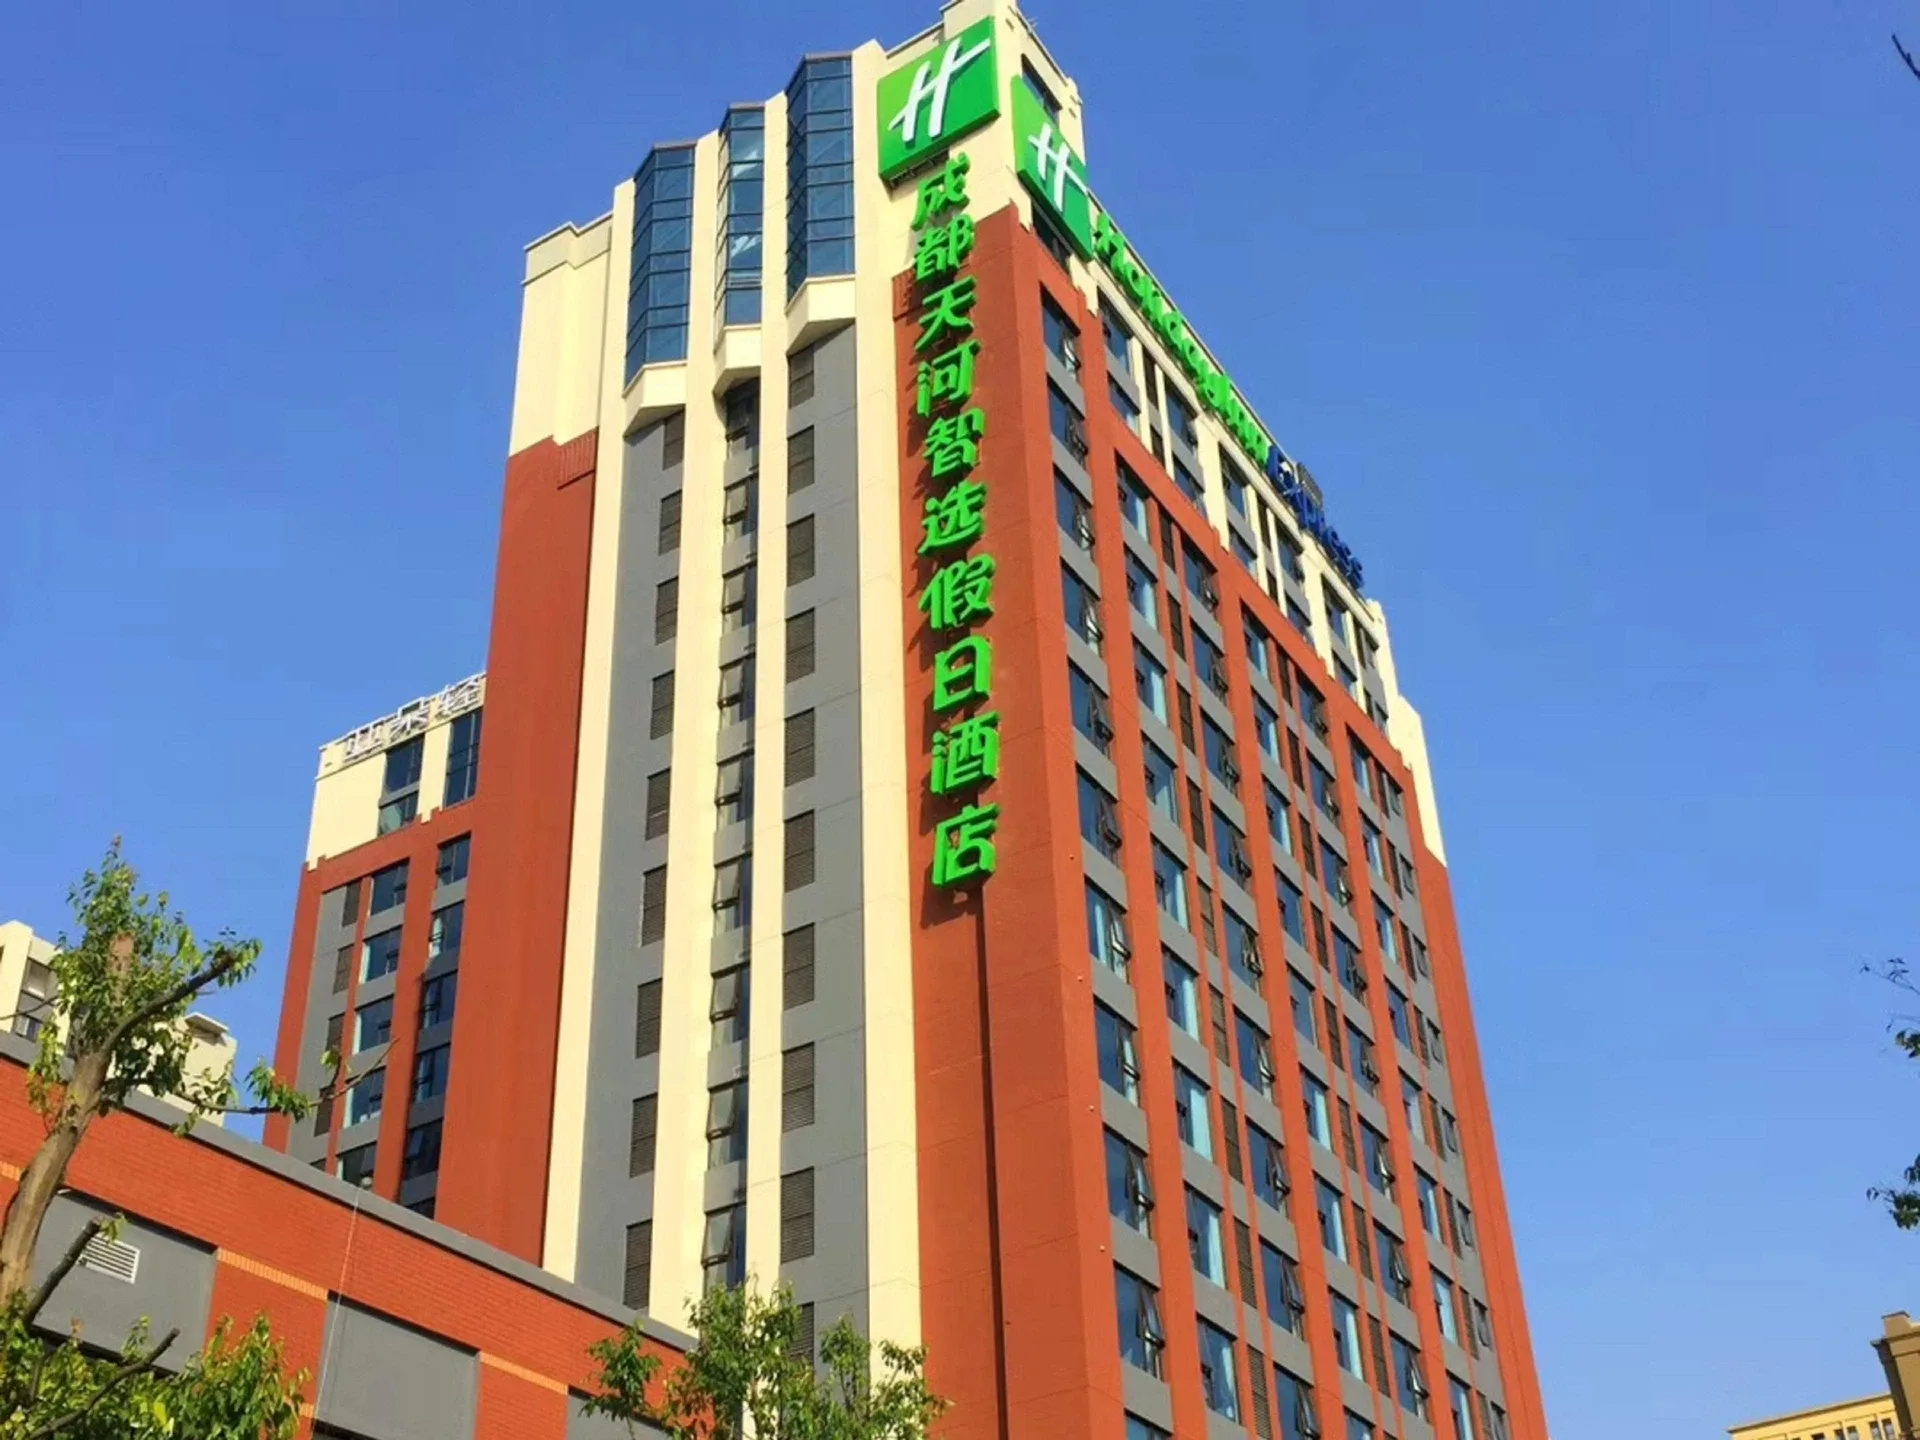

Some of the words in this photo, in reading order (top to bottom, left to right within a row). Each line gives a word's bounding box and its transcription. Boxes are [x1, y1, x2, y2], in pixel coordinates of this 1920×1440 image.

[911, 152, 1000, 887] 成都天河智选假日酒店
[1094, 211, 1224, 412] Holiday
